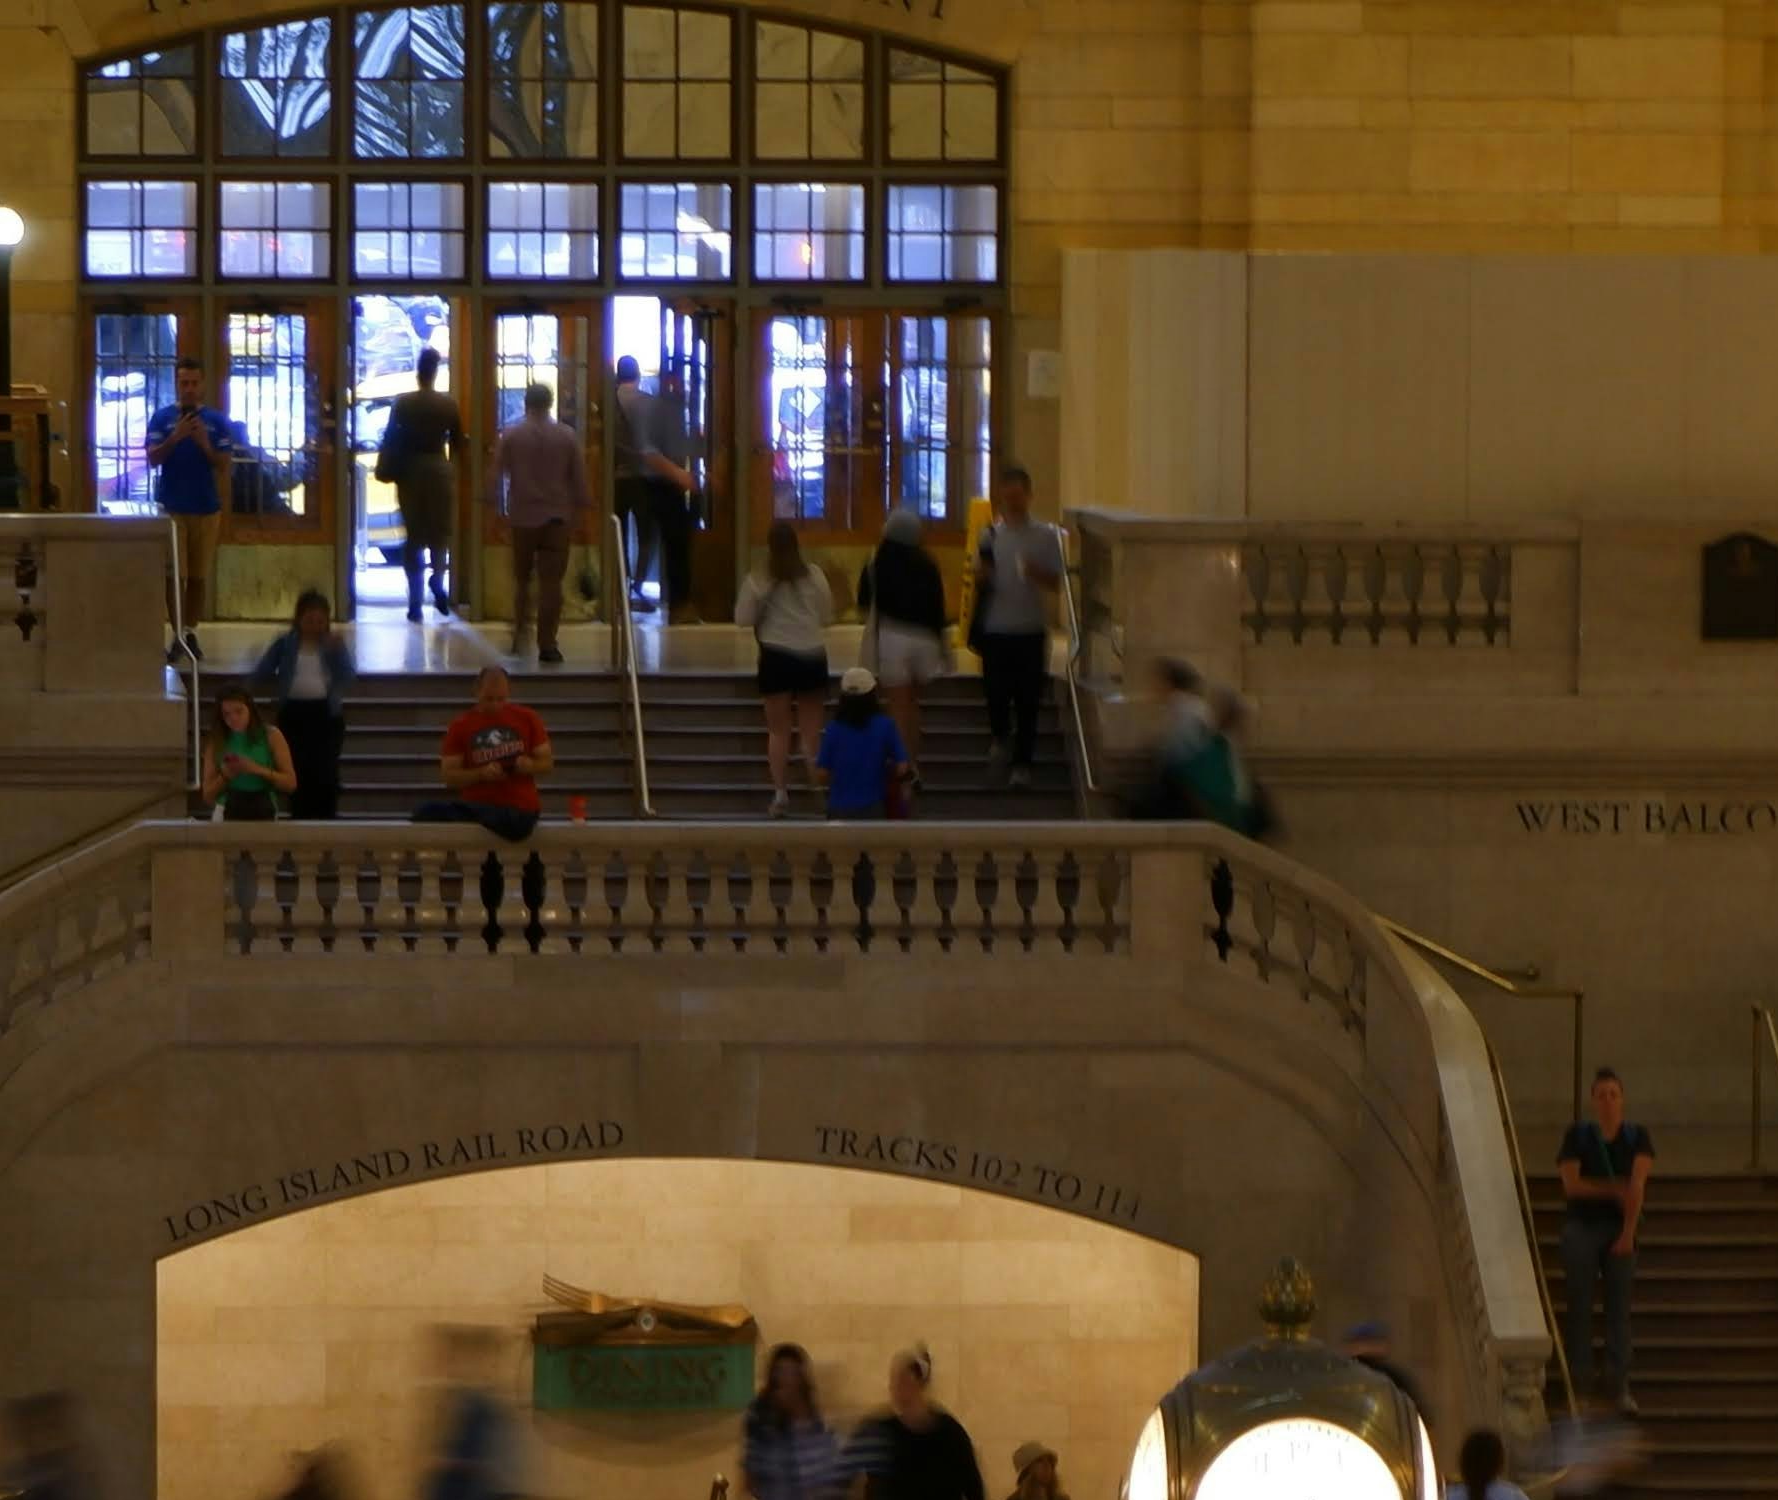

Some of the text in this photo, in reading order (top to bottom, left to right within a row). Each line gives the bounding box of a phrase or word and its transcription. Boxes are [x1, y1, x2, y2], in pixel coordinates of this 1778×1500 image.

[1515, 799, 1630, 833] WEST
[164, 1120, 623, 1242] LONG ISLAND RAIL ROAD
[815, 1125, 957, 1171] TRACKS
[970, 1152, 1022, 1188] 102
[1034, 1165, 1082, 1200] TO
